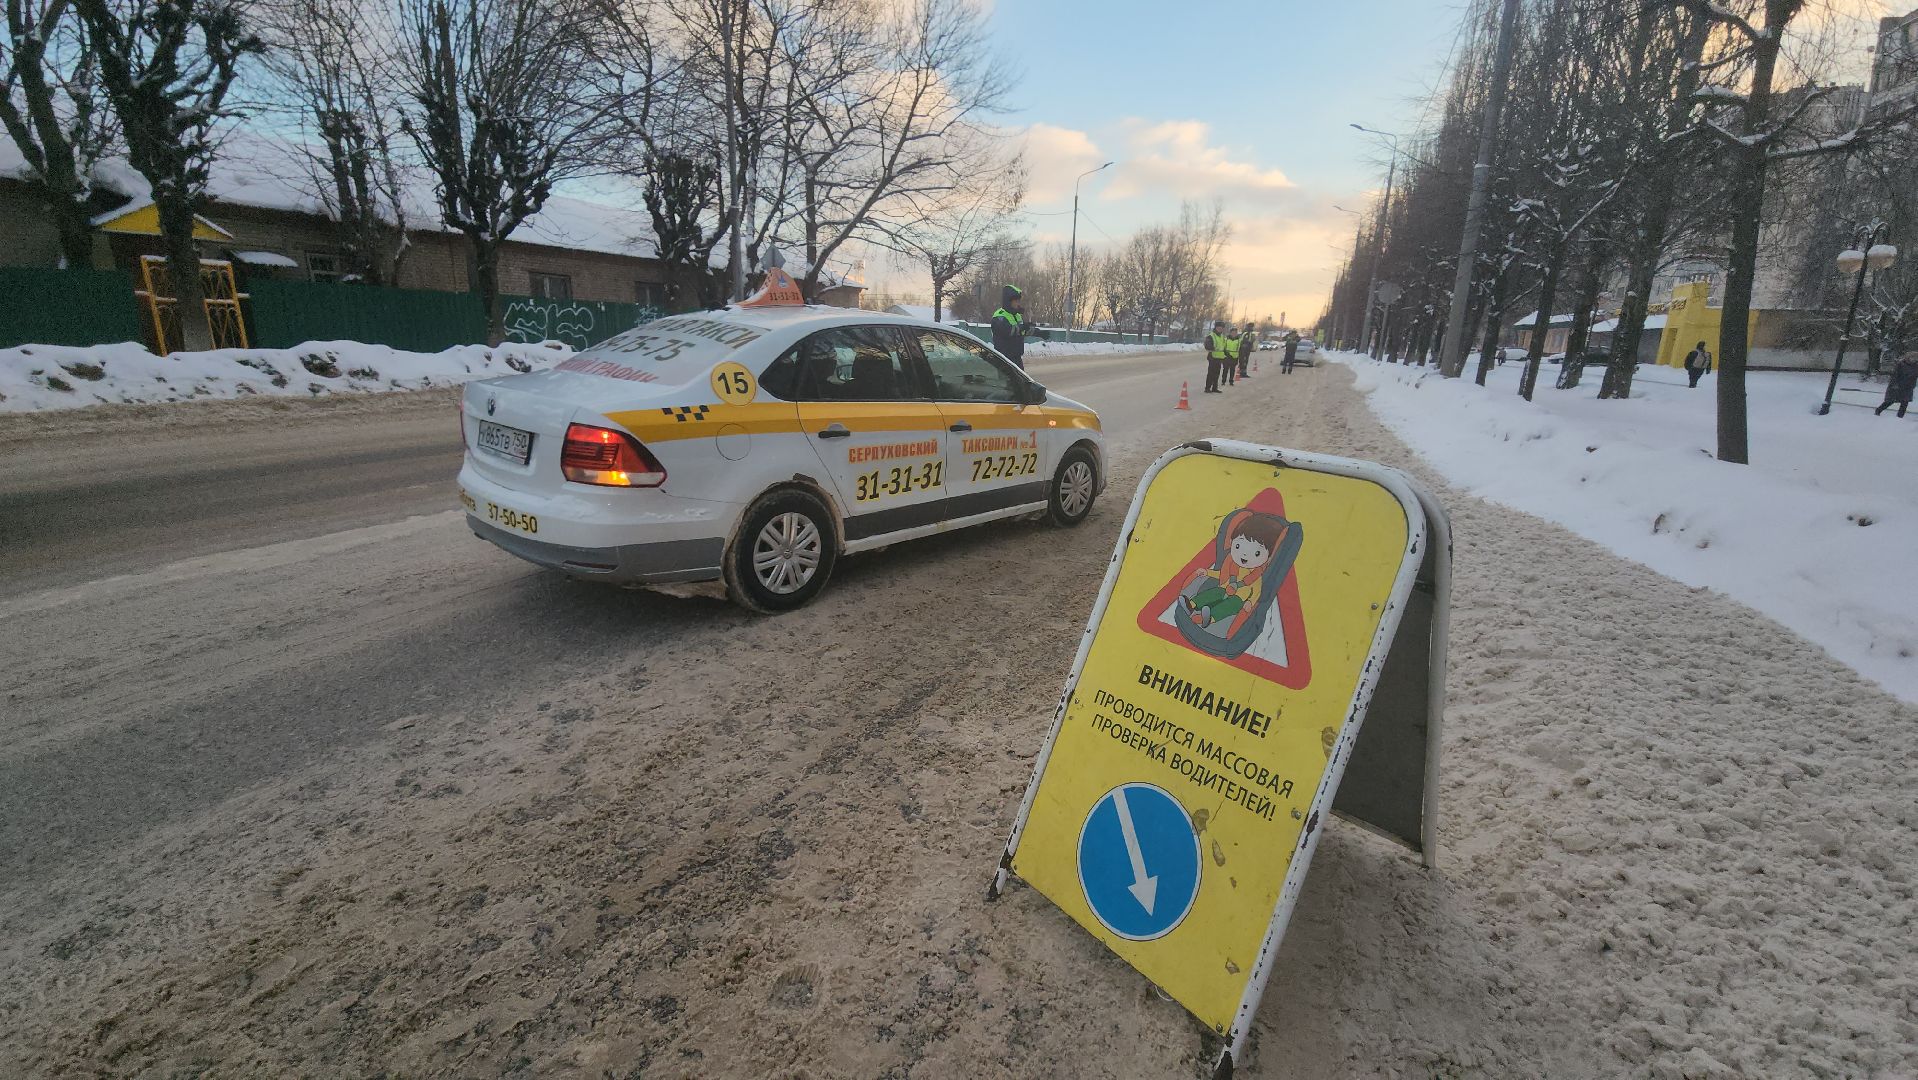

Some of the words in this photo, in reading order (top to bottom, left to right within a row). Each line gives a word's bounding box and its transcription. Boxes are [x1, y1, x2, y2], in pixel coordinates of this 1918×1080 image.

[768, 291, 800, 301] 31-31-31
[682, 320, 762, 350] ТАКСИ
[717, 371, 750, 395] 15
[512, 431, 527, 449] 750
[848, 438, 938, 464] СЕРПУХОВСКИЙ
[962, 436, 1018, 454] ТАКСОПАРК
[1029, 430, 1038, 449] 1
[856, 460, 944, 501] 31-31-31
[971, 452, 1039, 482] 72-72-72
[487, 501, 538, 534] 37-50-50
[1137, 664, 1272, 739] ВНИМАНИЕ!
[1094, 689, 1195, 749] ПРОВОДИТСЯ
[1196, 738, 1294, 799] МАССОВАЯ
[1091, 713, 1167, 764] ПРОВЕРКА
[1169, 752, 1277, 822] ВОДИТЕЛЕЙ!
